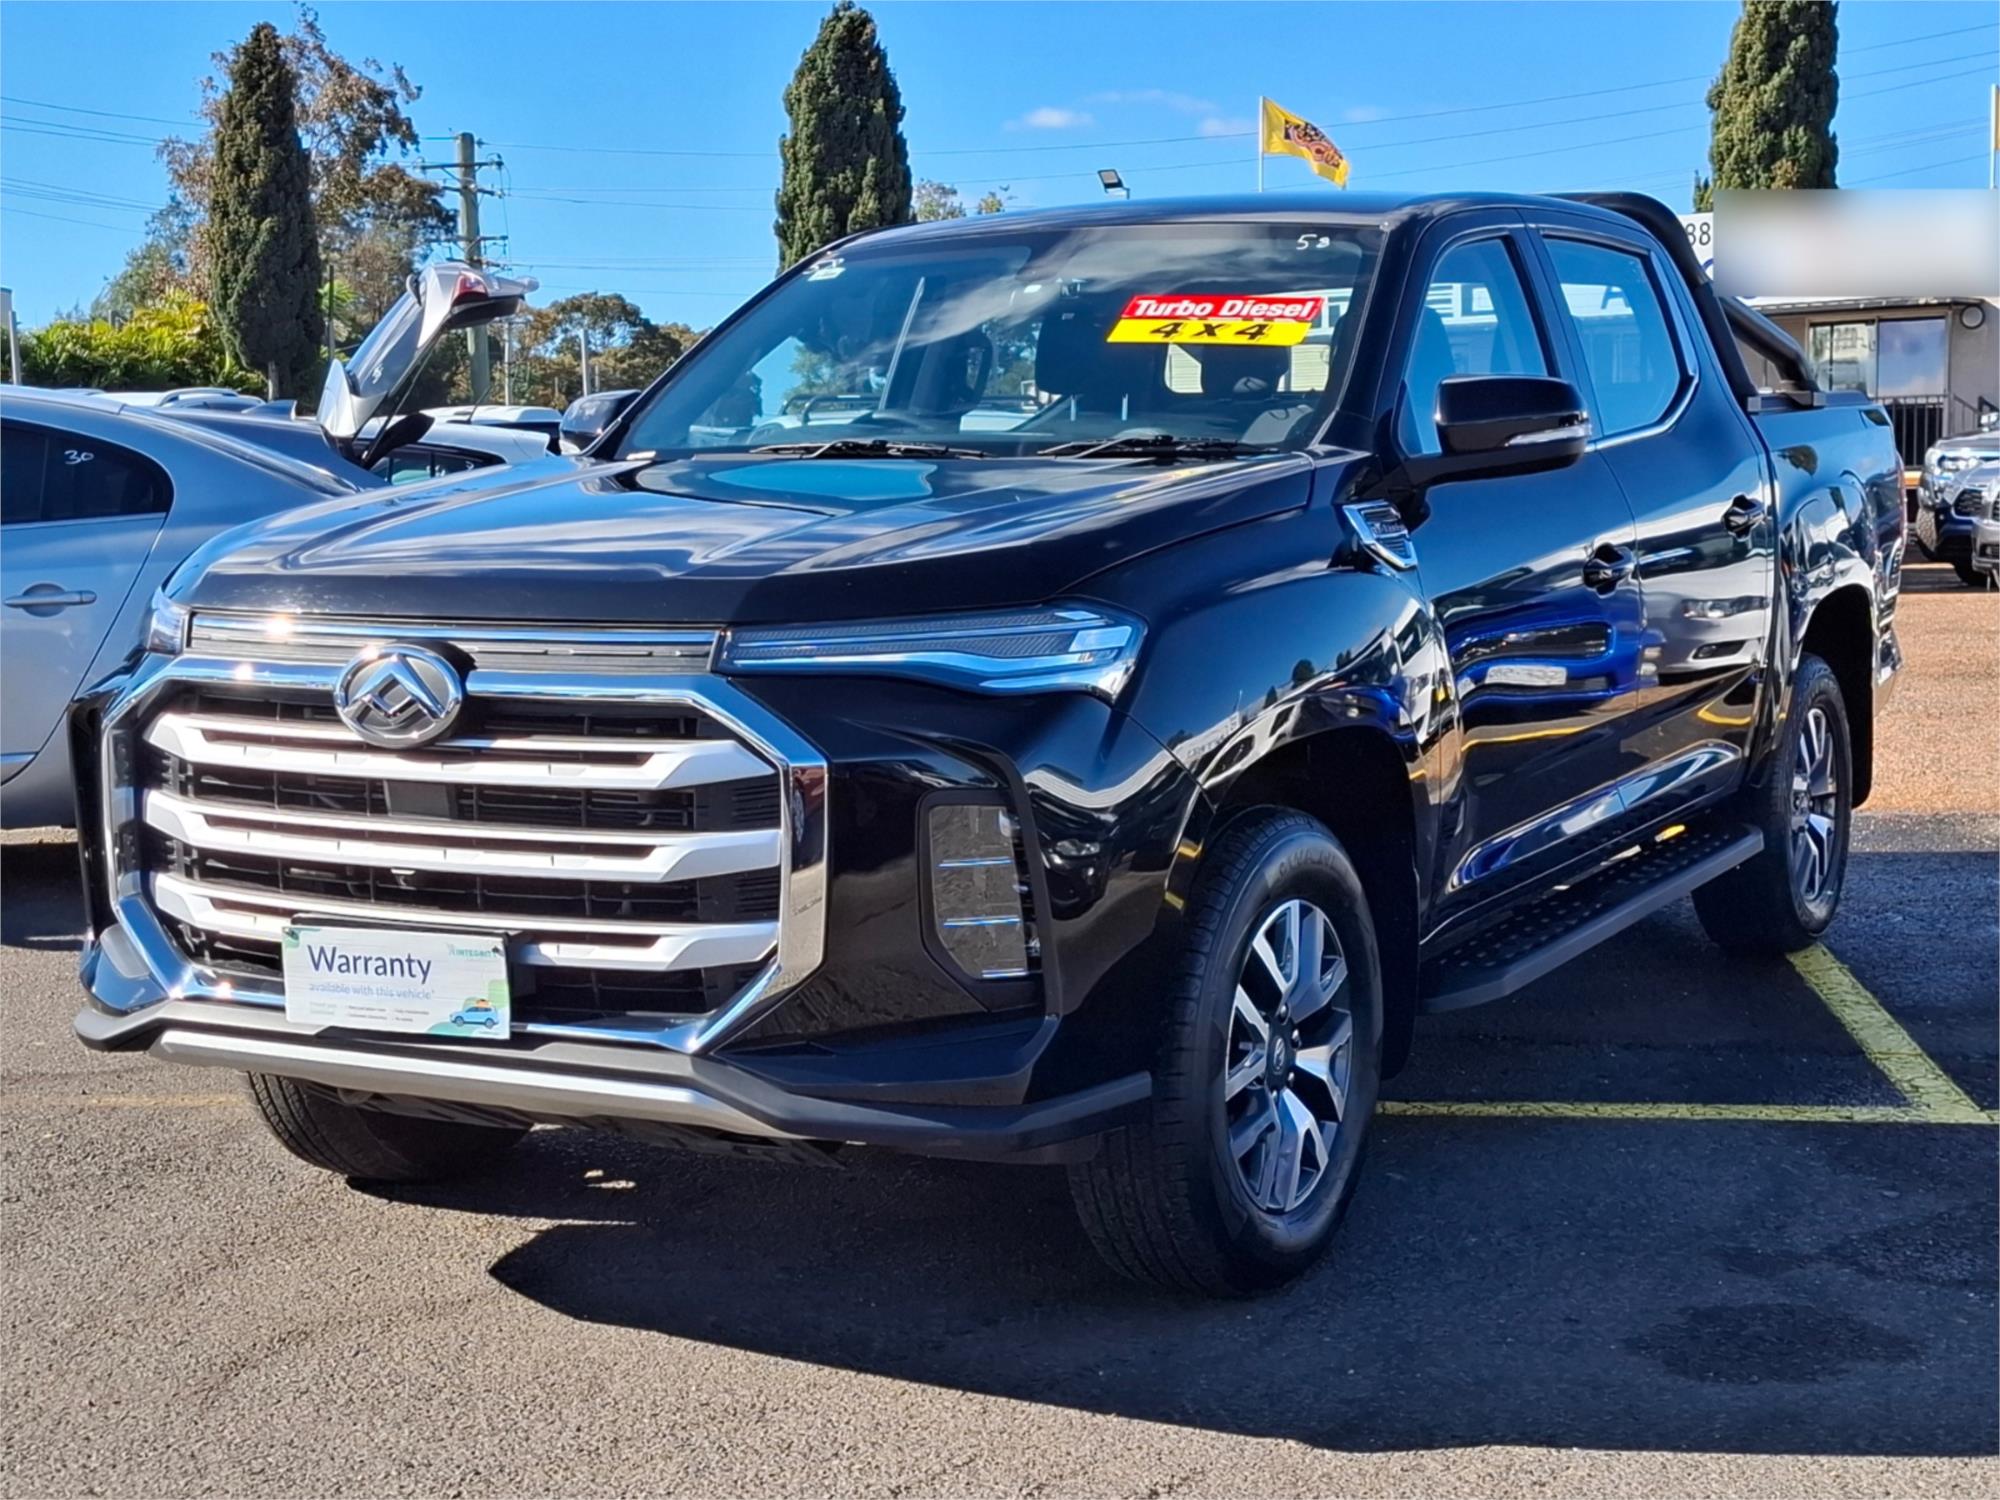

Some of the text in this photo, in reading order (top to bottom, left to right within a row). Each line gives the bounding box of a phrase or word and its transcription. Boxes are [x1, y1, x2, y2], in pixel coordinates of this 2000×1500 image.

[1134, 300, 1214, 317] Turbo
[1219, 300, 1315, 318] Diesel
[1150, 322, 1183, 338] 4
[1234, 324, 1272, 341] 4
[64, 449, 95, 464] 30
[307, 944, 432, 985] Warranty
[309, 983, 351, 995] available
[352, 984, 374, 997] with
[376, 985, 394, 998] this
